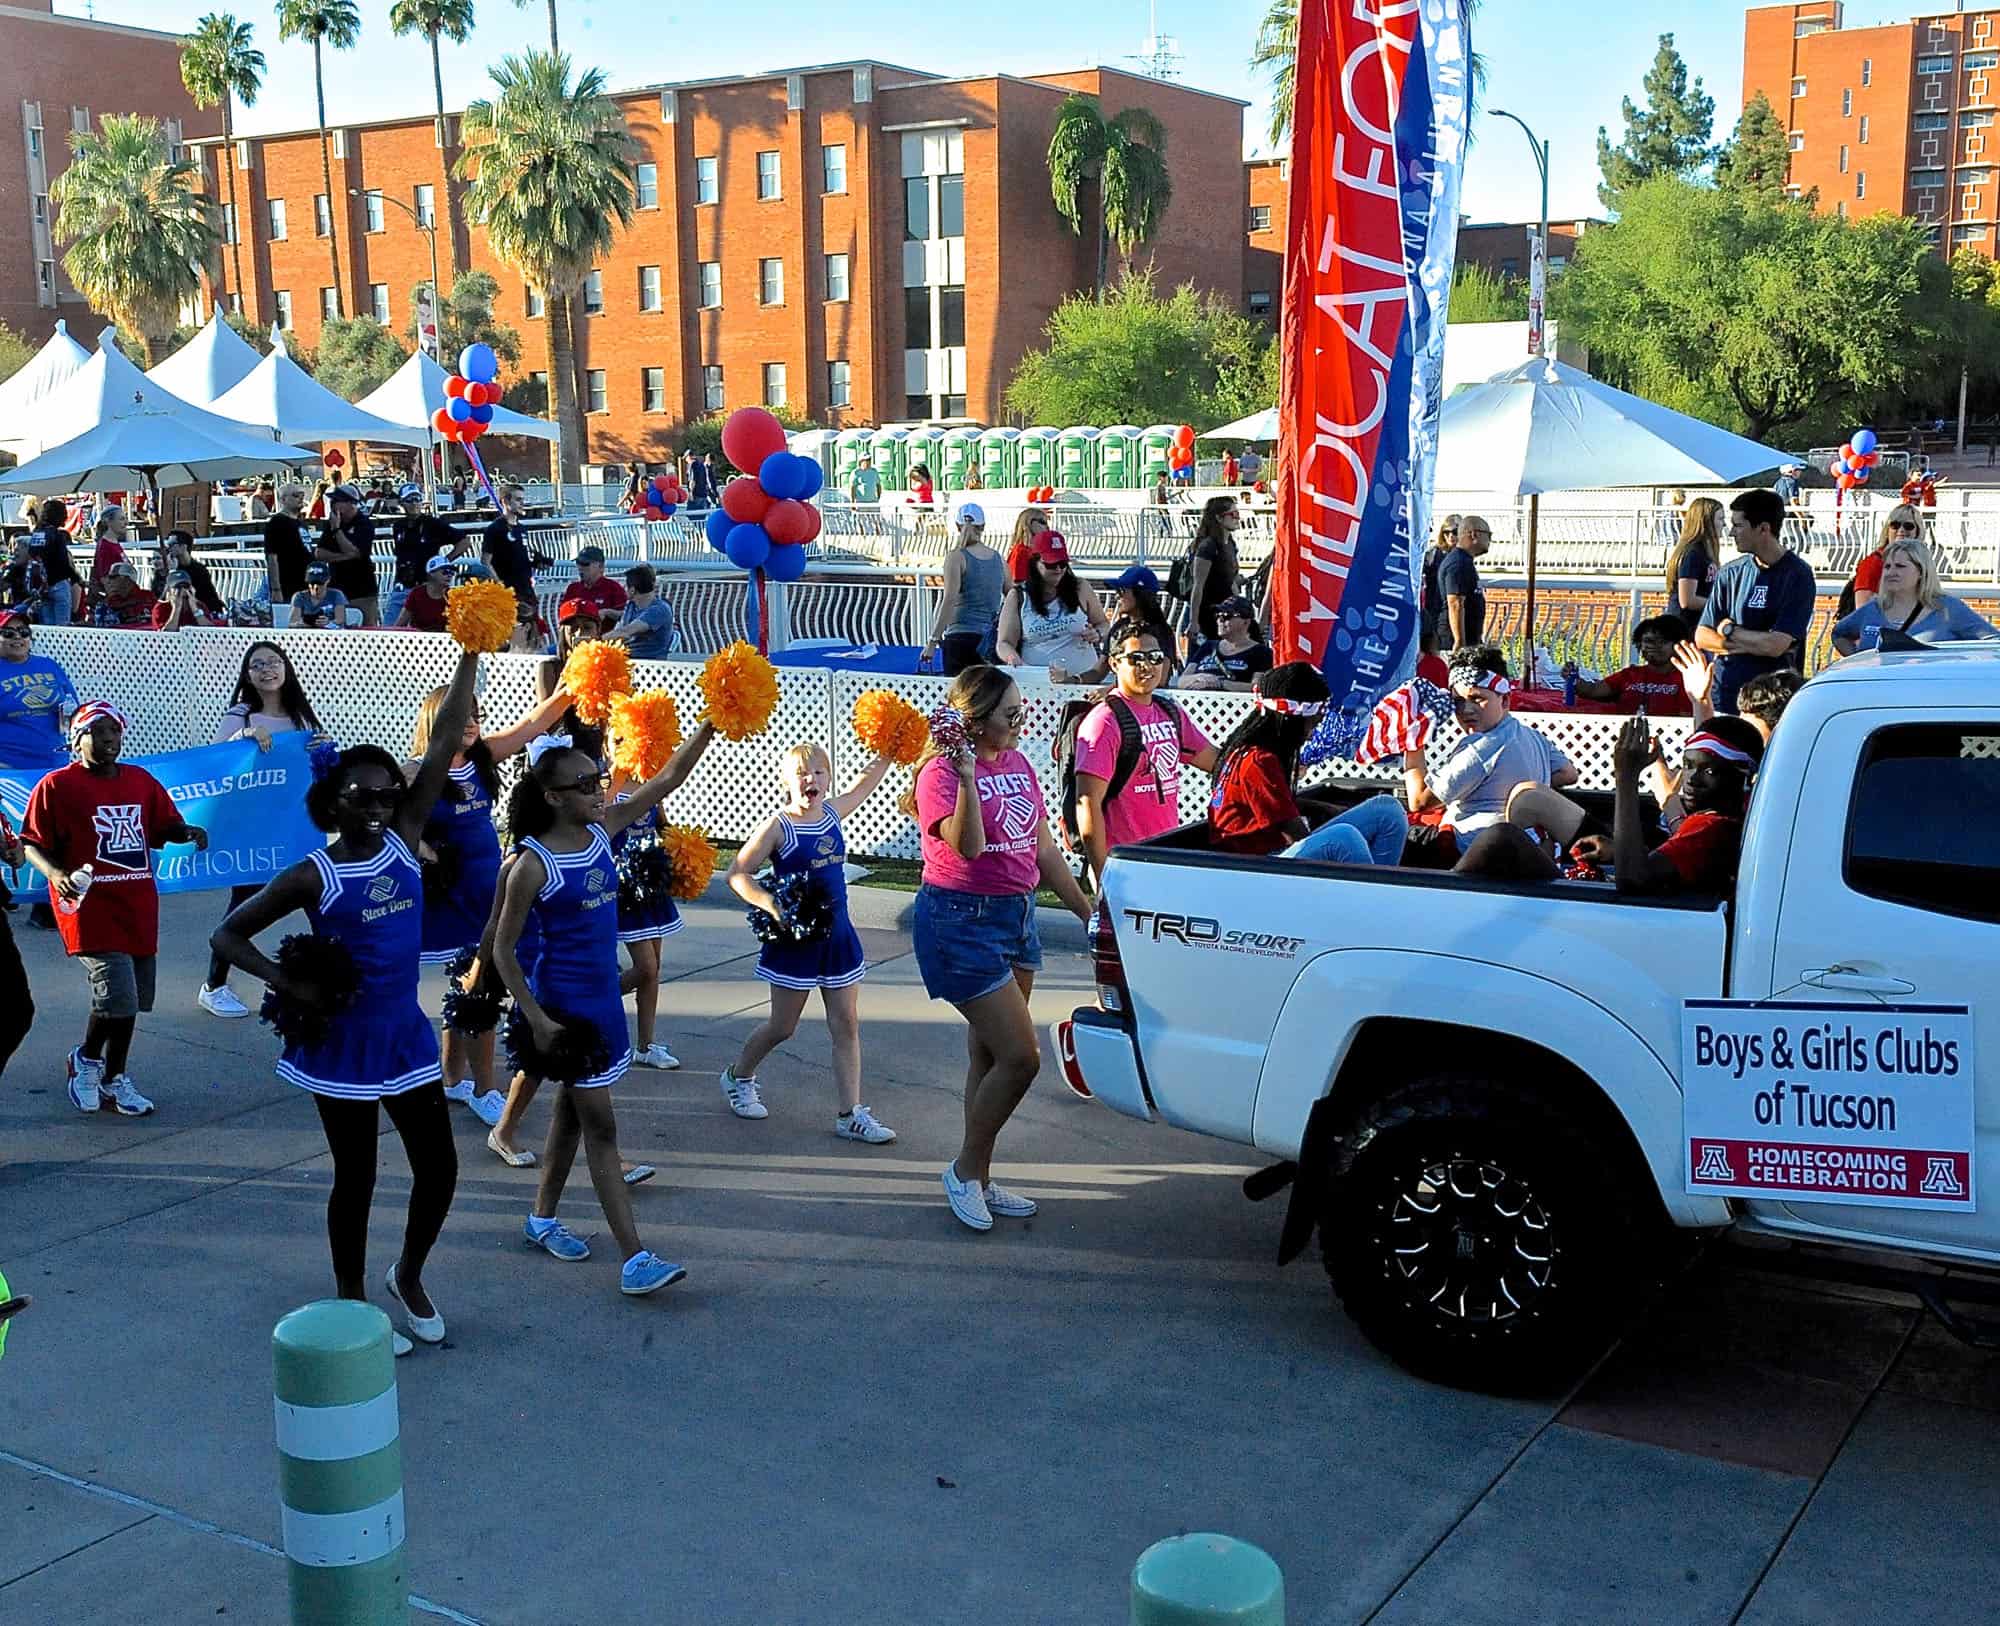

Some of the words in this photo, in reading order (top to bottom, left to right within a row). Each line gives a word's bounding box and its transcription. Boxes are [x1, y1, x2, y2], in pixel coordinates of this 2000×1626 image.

[1748, 586, 1769, 609] A
[1350, 637, 1390, 695] THE
[1140, 721, 1177, 745] TAFF
[168, 775, 233, 802] GIRLS
[237, 768, 287, 791] CLUB
[977, 773, 1032, 802] STAFF
[106, 817, 144, 854] A
[156, 846, 287, 881] UBHOUSE
[1123, 908, 1221, 947] TRD
[1223, 930, 1306, 953] SPORT
[1194, 941, 1219, 951] TOYOTA
[1219, 944, 1245, 954] RACING
[1246, 947, 1297, 961] DEVELOPMENT
[1695, 1024, 1764, 1079] Boys
[1771, 1026, 1794, 1070] &
[1801, 1022, 1868, 1073] Girls
[1875, 1026, 1960, 1076] Clubs
[1754, 1080, 1786, 1126] of
[1790, 1084, 1897, 1132] Tucson
[1695, 1145, 1734, 1182] A
[1747, 1146, 1908, 1173] HOMECOMING
[1920, 1157, 1964, 1197] A
[1749, 1165, 1908, 1192] CELEBRATION
